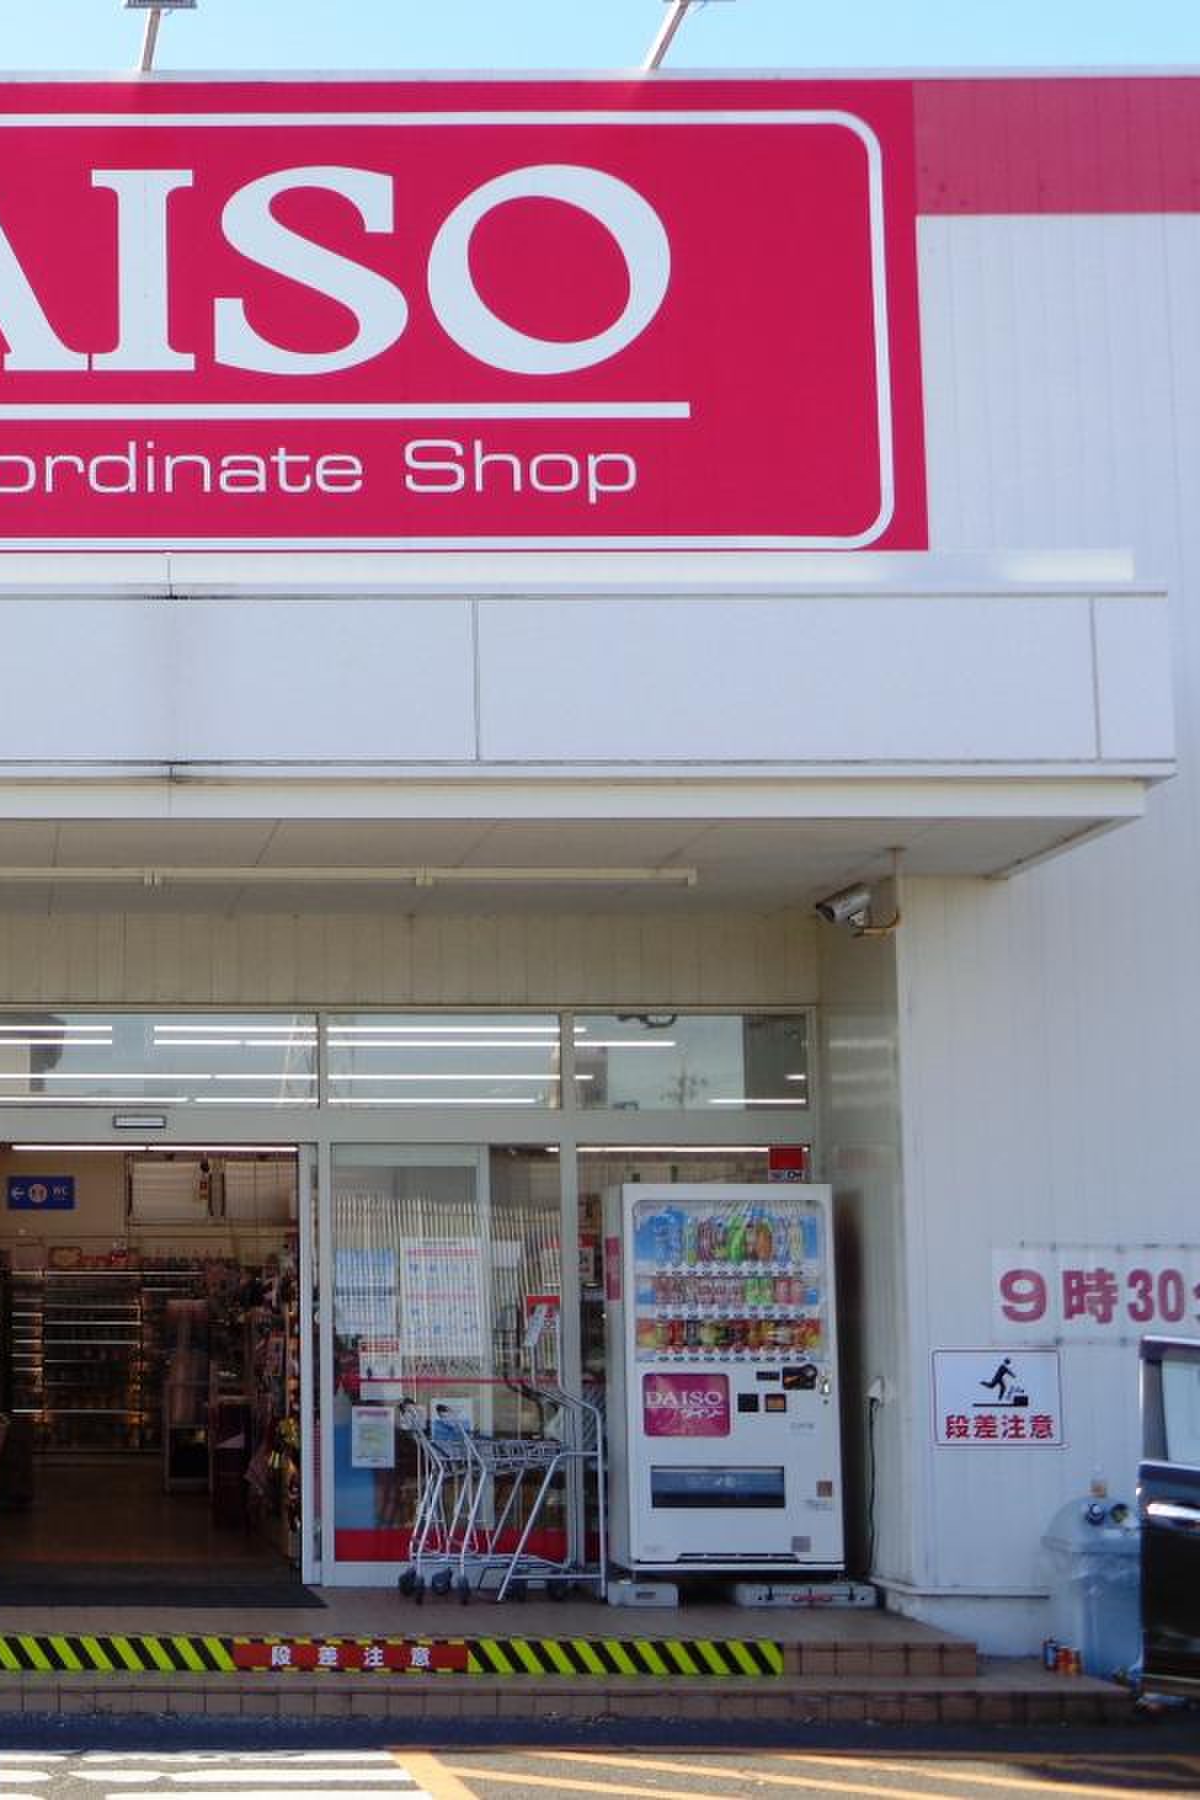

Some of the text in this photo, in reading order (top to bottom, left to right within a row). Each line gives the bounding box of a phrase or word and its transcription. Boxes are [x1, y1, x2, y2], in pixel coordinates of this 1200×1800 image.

[404, 439, 638, 504] Shop
[646, 1391, 724, 1407] DAISO
[945, 1414, 1054, 1440] 段差注意
[272, 1645, 430, 1666] 段差注意
